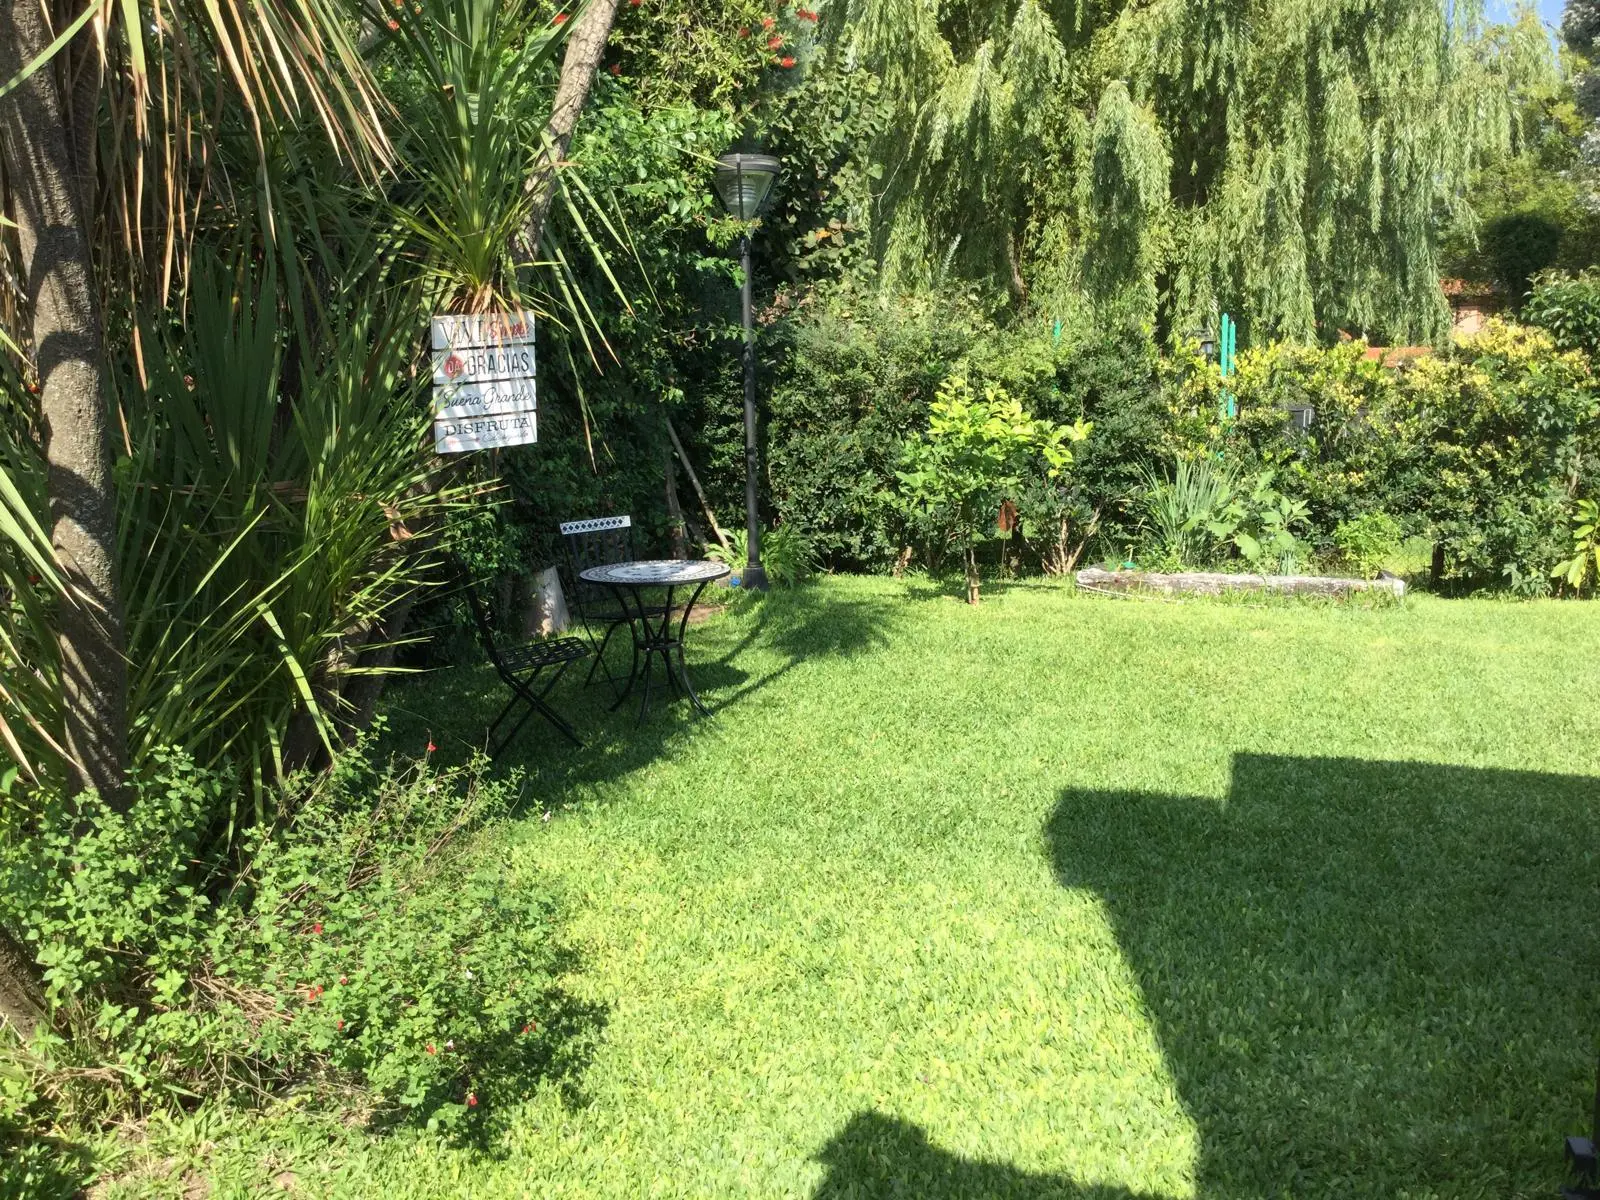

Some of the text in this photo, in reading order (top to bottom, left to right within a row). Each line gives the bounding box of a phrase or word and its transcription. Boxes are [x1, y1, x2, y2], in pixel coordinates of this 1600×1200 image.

[467, 352, 529, 375] GRACIAS
[443, 385, 531, 411] Sueña Grande
[445, 418, 529, 436] DISFRUTA
